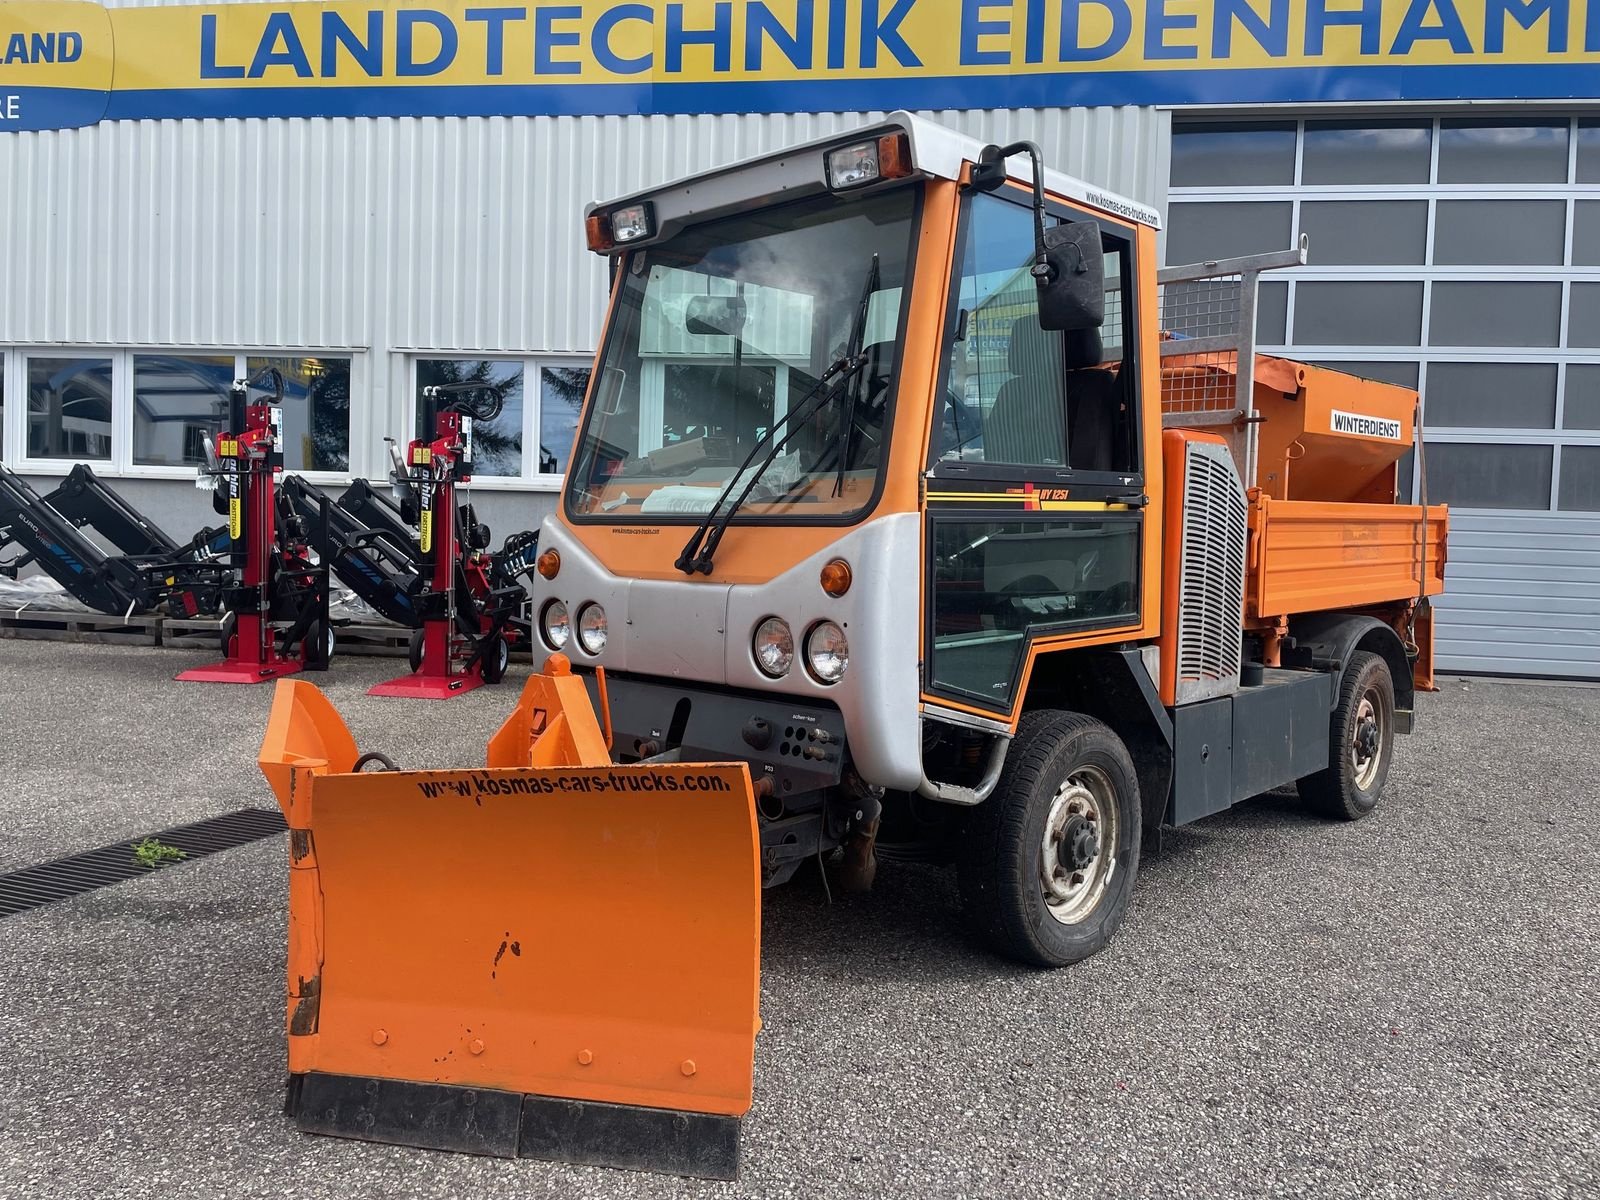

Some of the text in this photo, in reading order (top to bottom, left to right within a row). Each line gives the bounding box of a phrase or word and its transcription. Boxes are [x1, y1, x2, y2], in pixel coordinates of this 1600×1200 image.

[0, 32, 83, 64] AND
[200, 0, 1600, 78] LANDTECHNIK EIDENHAM
[1086, 191, 1158, 226] www.kosmas-cars-trucks.com
[1334, 413, 1399, 438] WINTERDIENST
